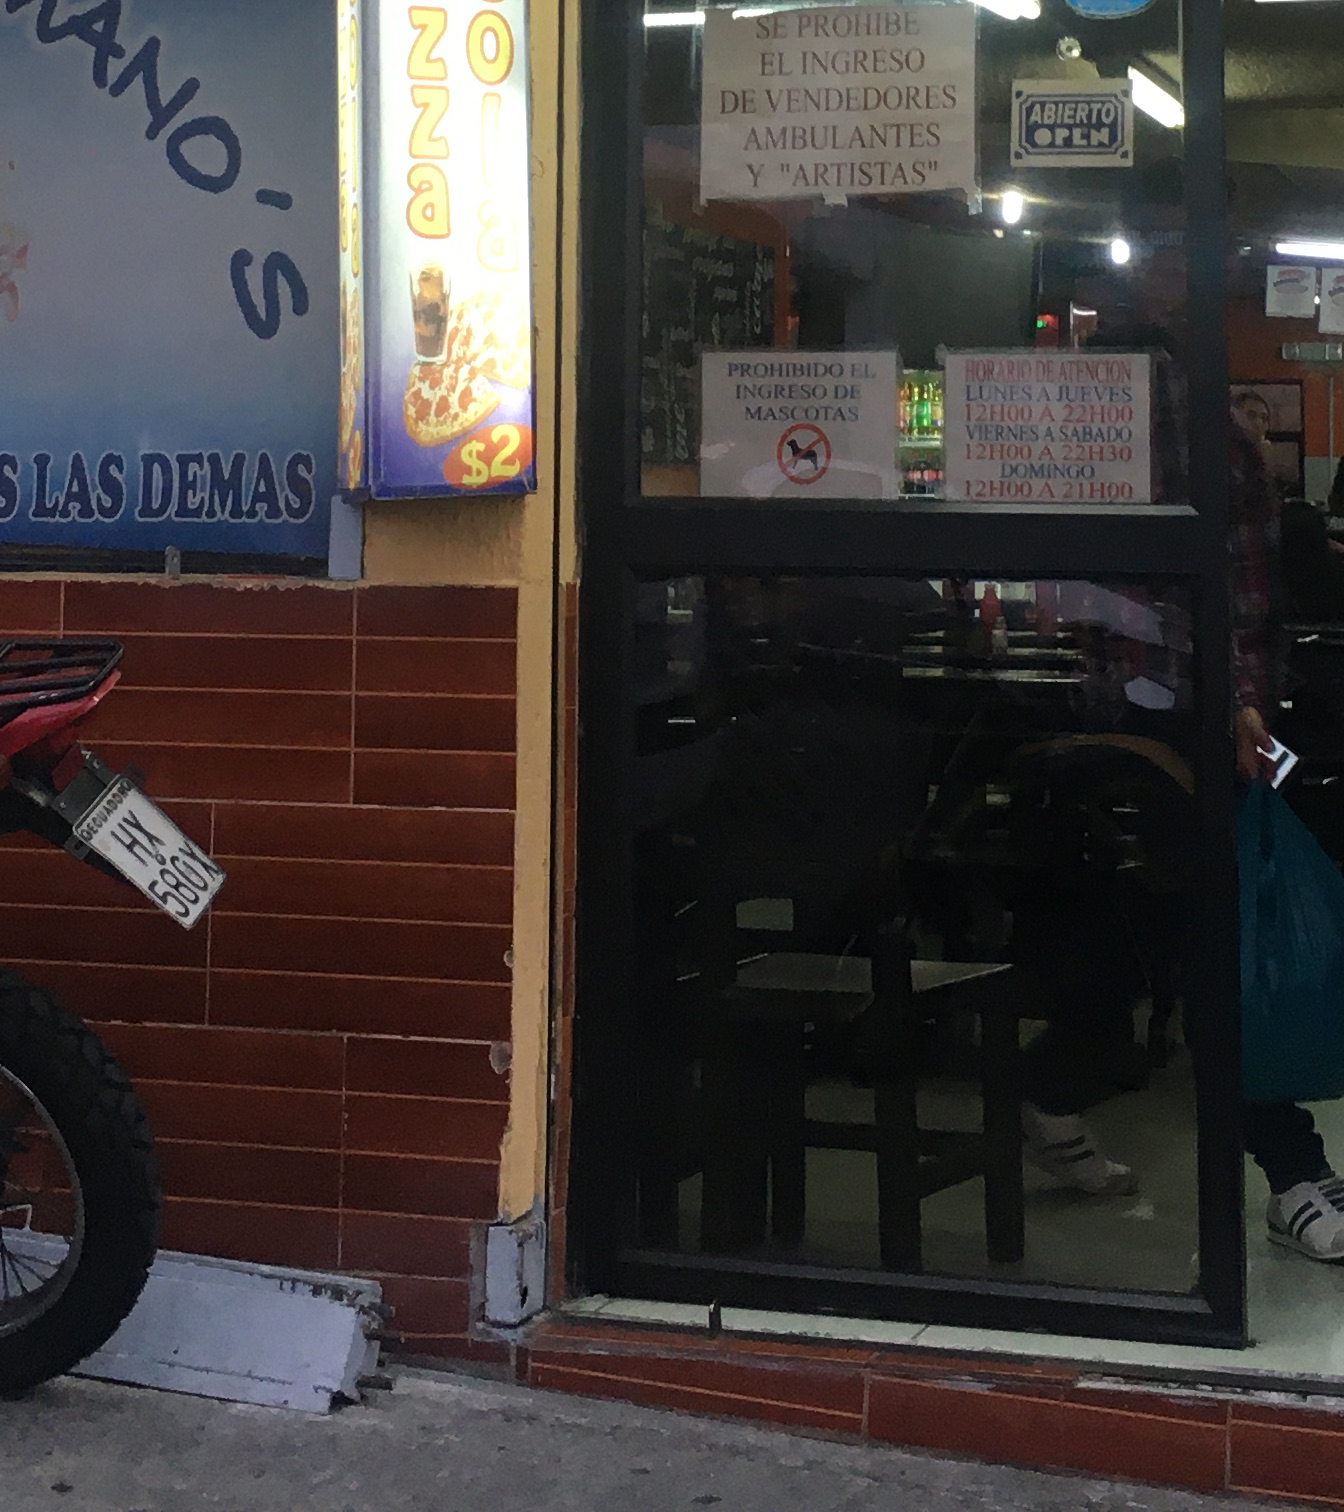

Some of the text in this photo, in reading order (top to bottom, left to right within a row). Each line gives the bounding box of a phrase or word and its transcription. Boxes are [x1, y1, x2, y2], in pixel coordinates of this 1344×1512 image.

[756, 11, 920, 39] SE PROHIBE
[760, 47, 925, 76] EL INGRESO
[720, 85, 957, 114] DE VENDEDORES
[1029, 103, 1115, 125] ABIERTO
[743, 123, 941, 151] AMBULANTES
[746, 160, 938, 188] Y "ARTISTAS"
[728, 362, 877, 379] PROHIBIDO EL
[965, 360, 1132, 382] HORARIO DE ATENCION
[736, 384, 861, 400] INGRESO DE
[966, 385, 1133, 402] LUNES A JUEVES
[745, 406, 859, 421] MASCOTAS
[966, 404, 1133, 423] 12H00 A 22H00
[966, 424, 1133, 443] VIERNES A SABADO
[461, 424, 521, 487] $2
[966, 443, 1133, 462] 12H00 A 22H30
[1000, 463, 1095, 479] DOMINGO
[32, 451, 125, 523] LAS
[137, 451, 315, 523] DEMAS
[966, 480, 1133, 499] 12H00 A 21H00
